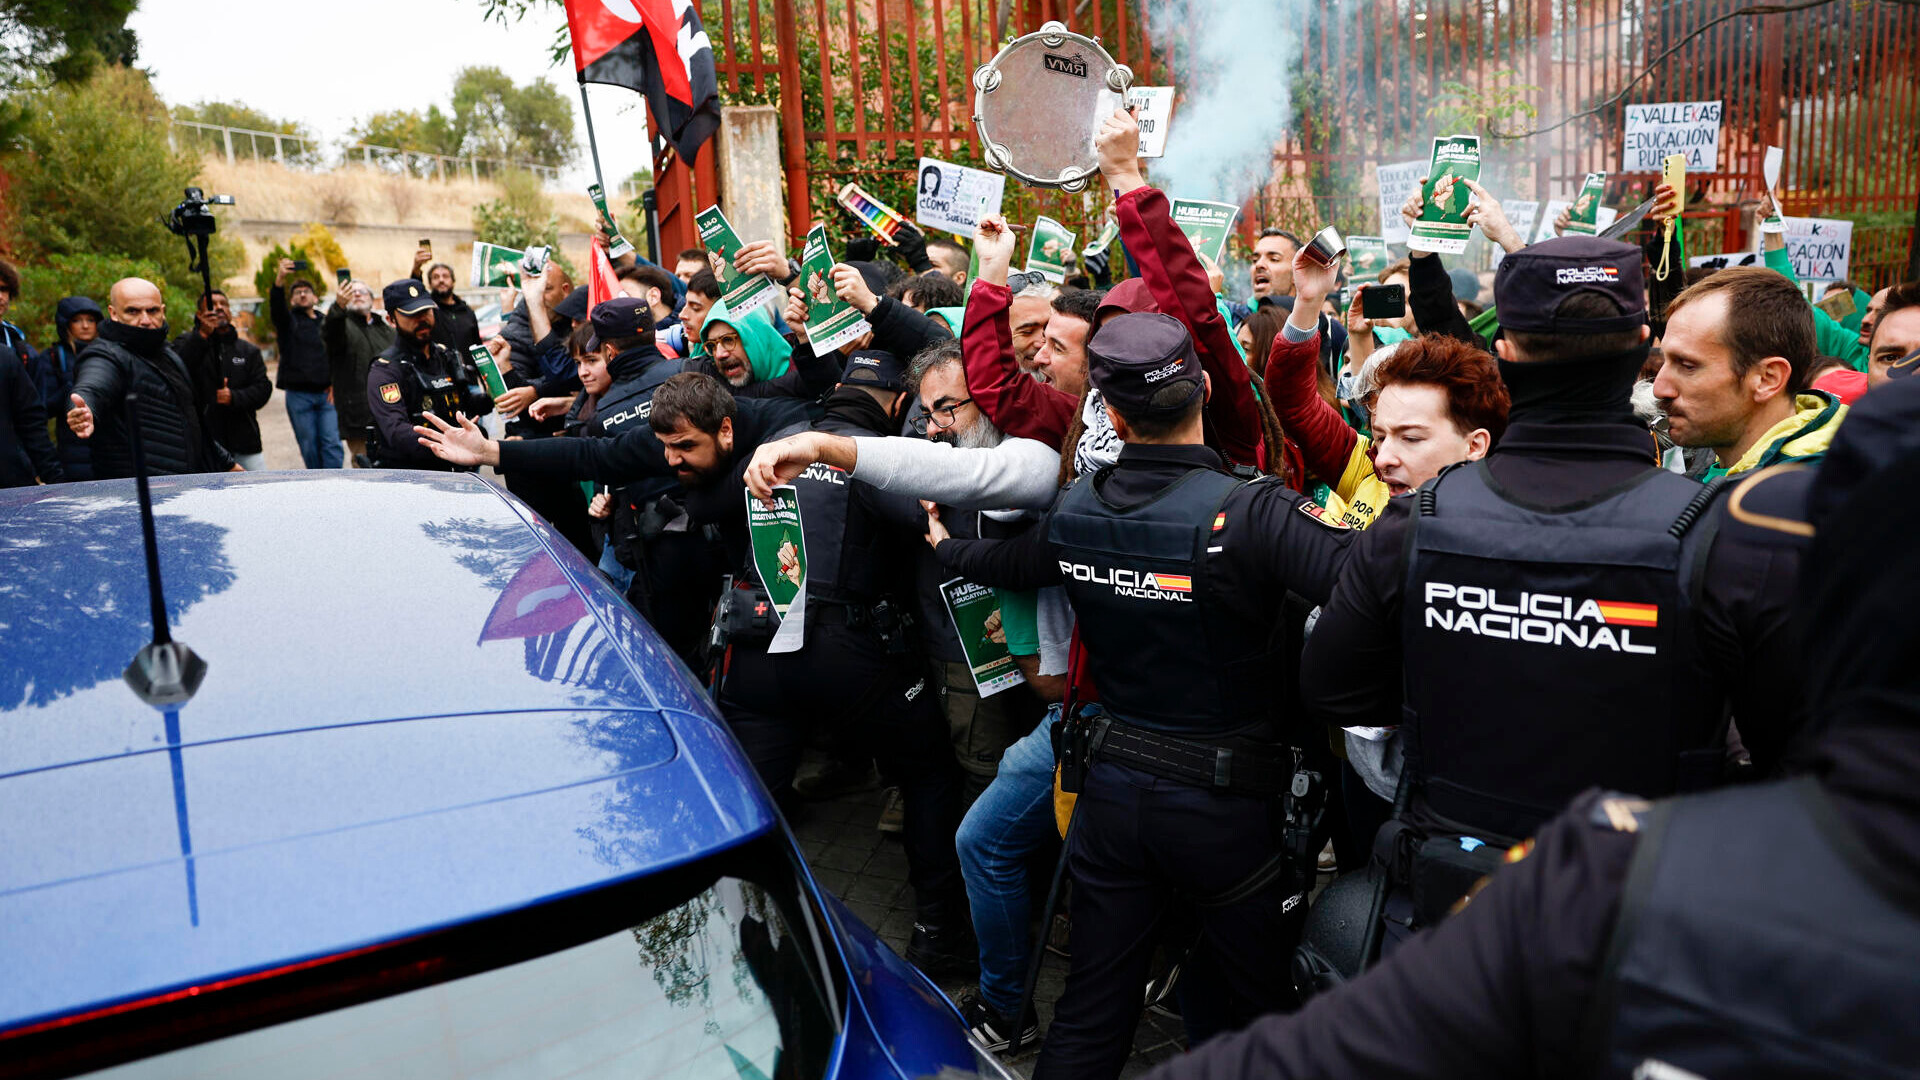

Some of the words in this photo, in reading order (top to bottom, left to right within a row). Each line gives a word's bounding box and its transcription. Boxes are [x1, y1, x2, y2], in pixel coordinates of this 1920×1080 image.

[1641, 105, 1721, 124] VALLEKAS
[1627, 125, 1714, 149] EDUCACIÓN
[1639, 149, 1703, 167] PUBKA
[1175, 205, 1213, 218] HUELGA
[1787, 222, 1839, 238] LLEKAS
[1760, 239, 1845, 260] ECACIÓN
[1556, 266, 1606, 277] POLICIA
[1557, 274, 1619, 284] NACIONAL
[1144, 362, 1177, 379] POLICIA
[1146, 365, 1184, 384] NACIONAL
[602, 400, 653, 431] POLICI
[751, 496, 788, 512] HUEGA
[1352, 500, 1374, 518] POR
[1058, 560, 1160, 590] POLICIA
[953, 589, 988, 605] EDUCATIVA
[1115, 586, 1193, 602] NACIONAL
[1425, 582, 1606, 623] POLICIA
[1425, 606, 1657, 655] NACIONAL
